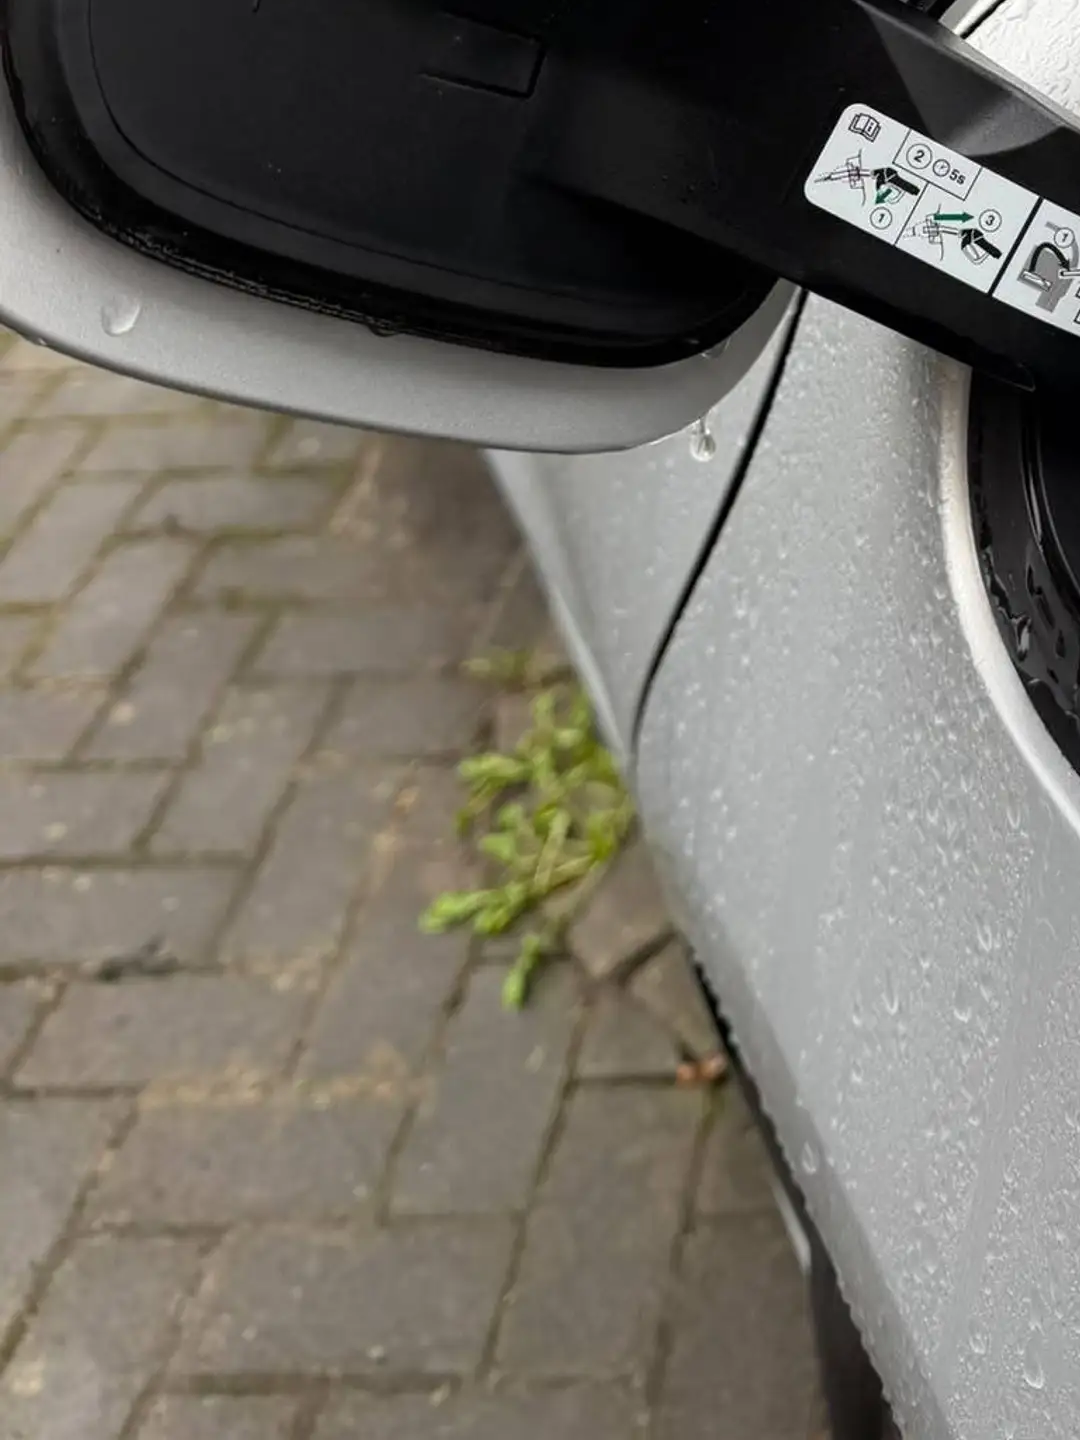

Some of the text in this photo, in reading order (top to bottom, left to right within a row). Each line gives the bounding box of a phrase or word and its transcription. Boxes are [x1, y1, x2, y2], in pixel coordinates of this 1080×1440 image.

[916, 148, 926, 163] 2
[949, 168, 966, 185] 5s
[877, 213, 886, 224] 1
[986, 214, 997, 227] 3
[1061, 231, 1070, 243] 1
